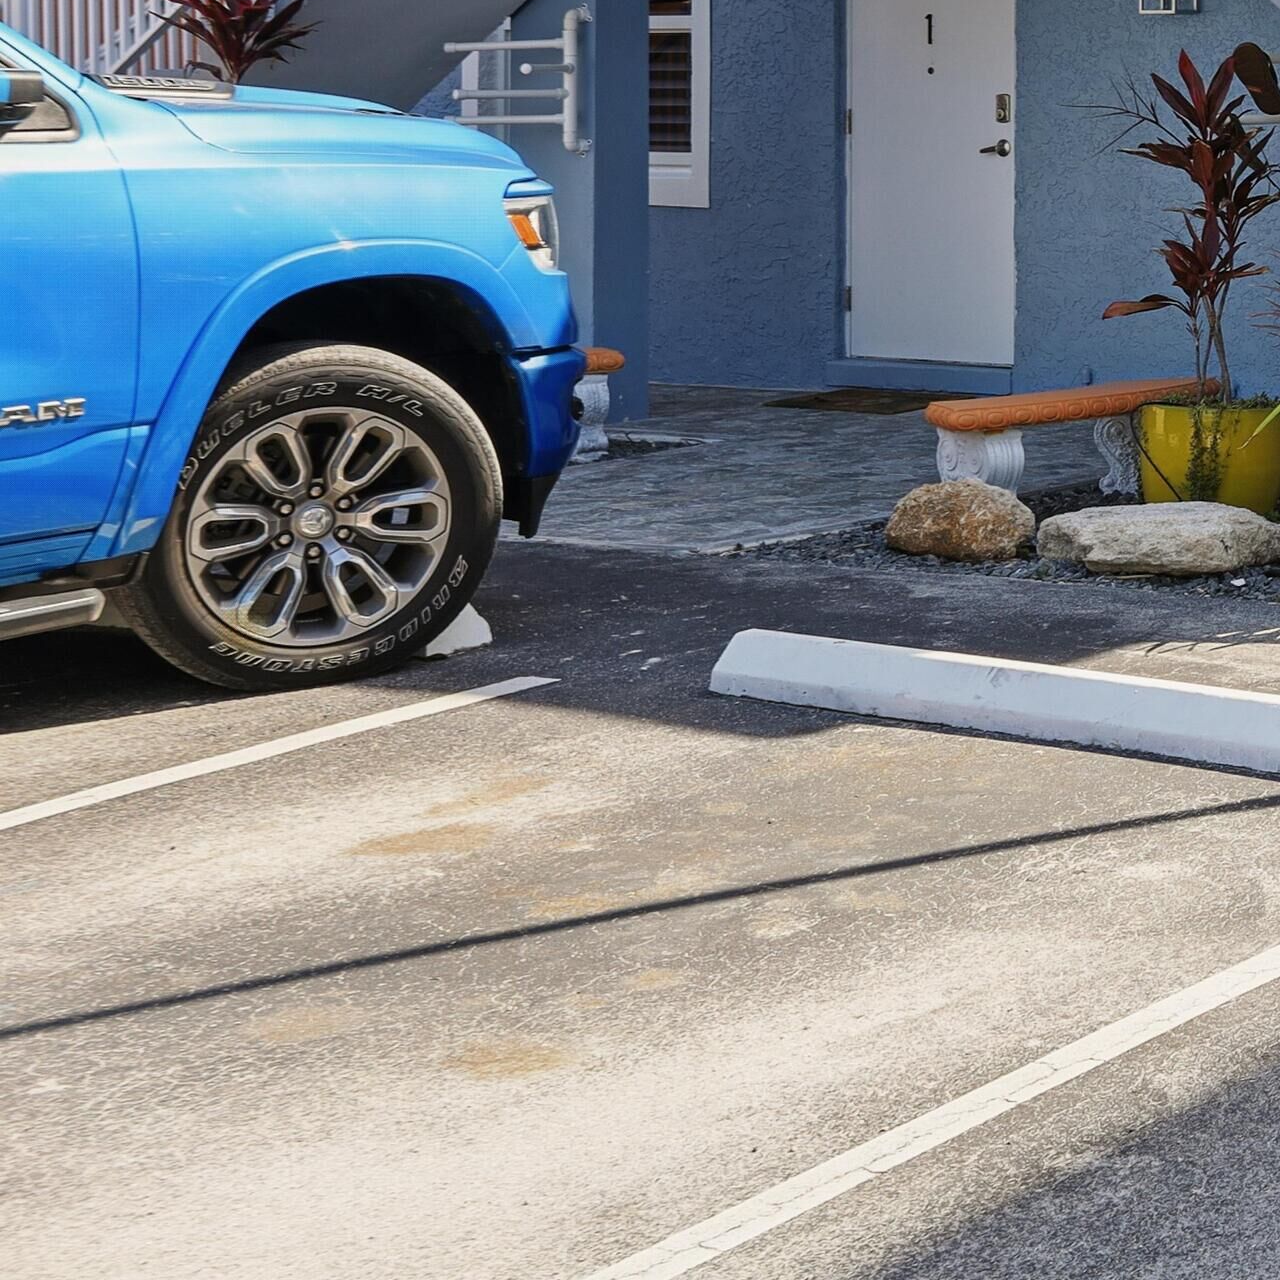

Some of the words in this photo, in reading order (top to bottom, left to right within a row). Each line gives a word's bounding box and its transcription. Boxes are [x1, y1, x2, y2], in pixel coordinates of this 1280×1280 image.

[924, 13, 933, 45] 1
[0, 397, 87, 427] AM
[208, 553, 469, 673] BRIDGESTONE
